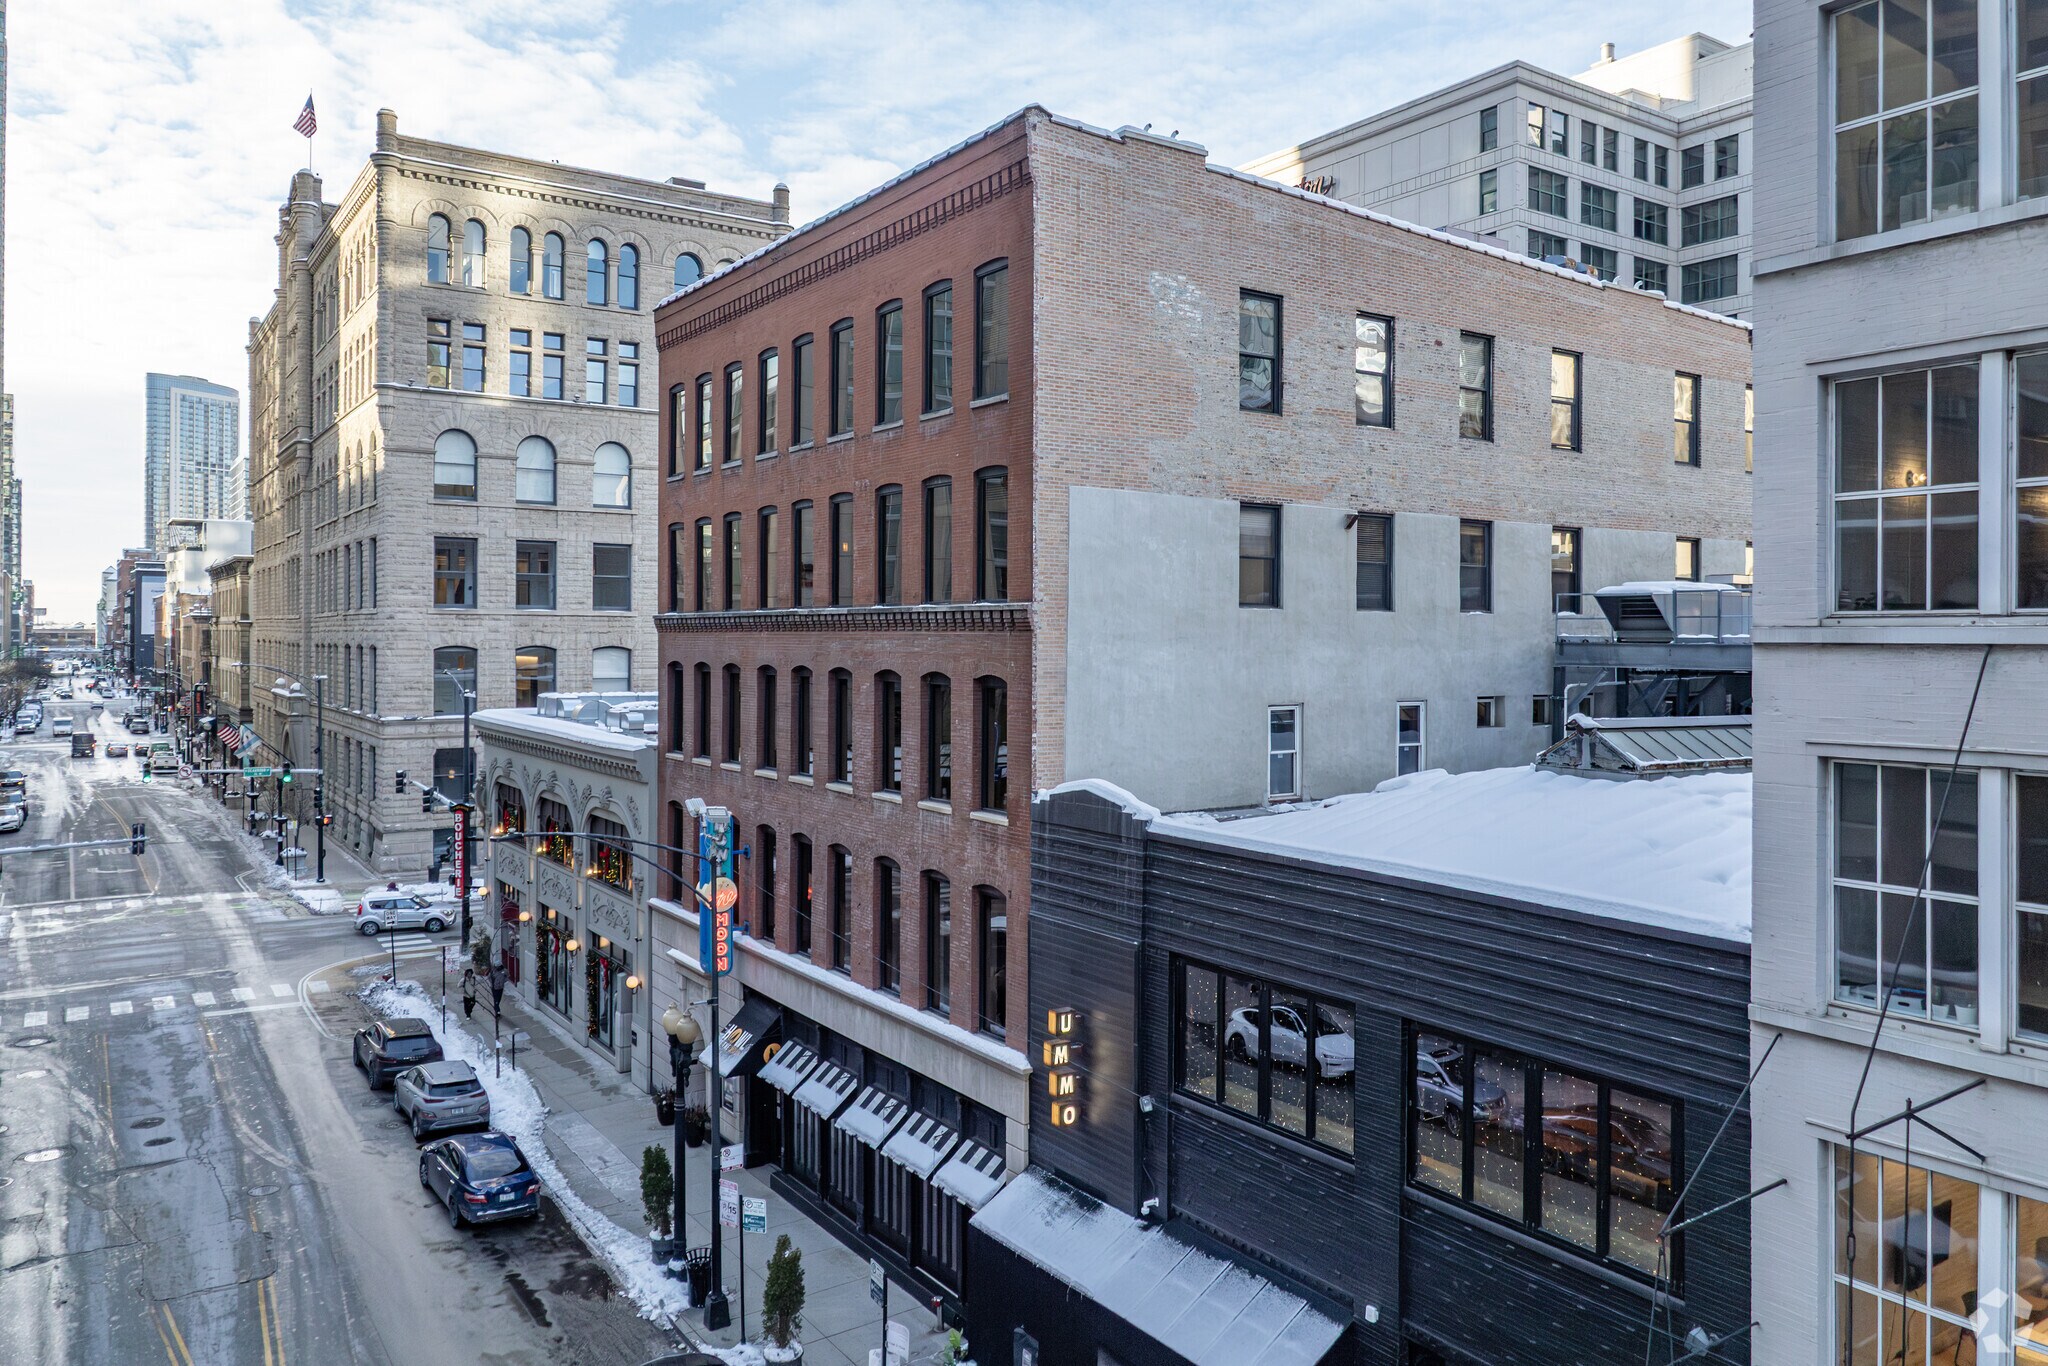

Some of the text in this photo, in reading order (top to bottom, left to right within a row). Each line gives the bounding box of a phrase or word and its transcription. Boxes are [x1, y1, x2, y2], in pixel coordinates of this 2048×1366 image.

[454, 813, 463, 896] BOUCHERIE
[716, 911, 729, 972] MOON
[1053, 1013, 1076, 1126] UMMO
